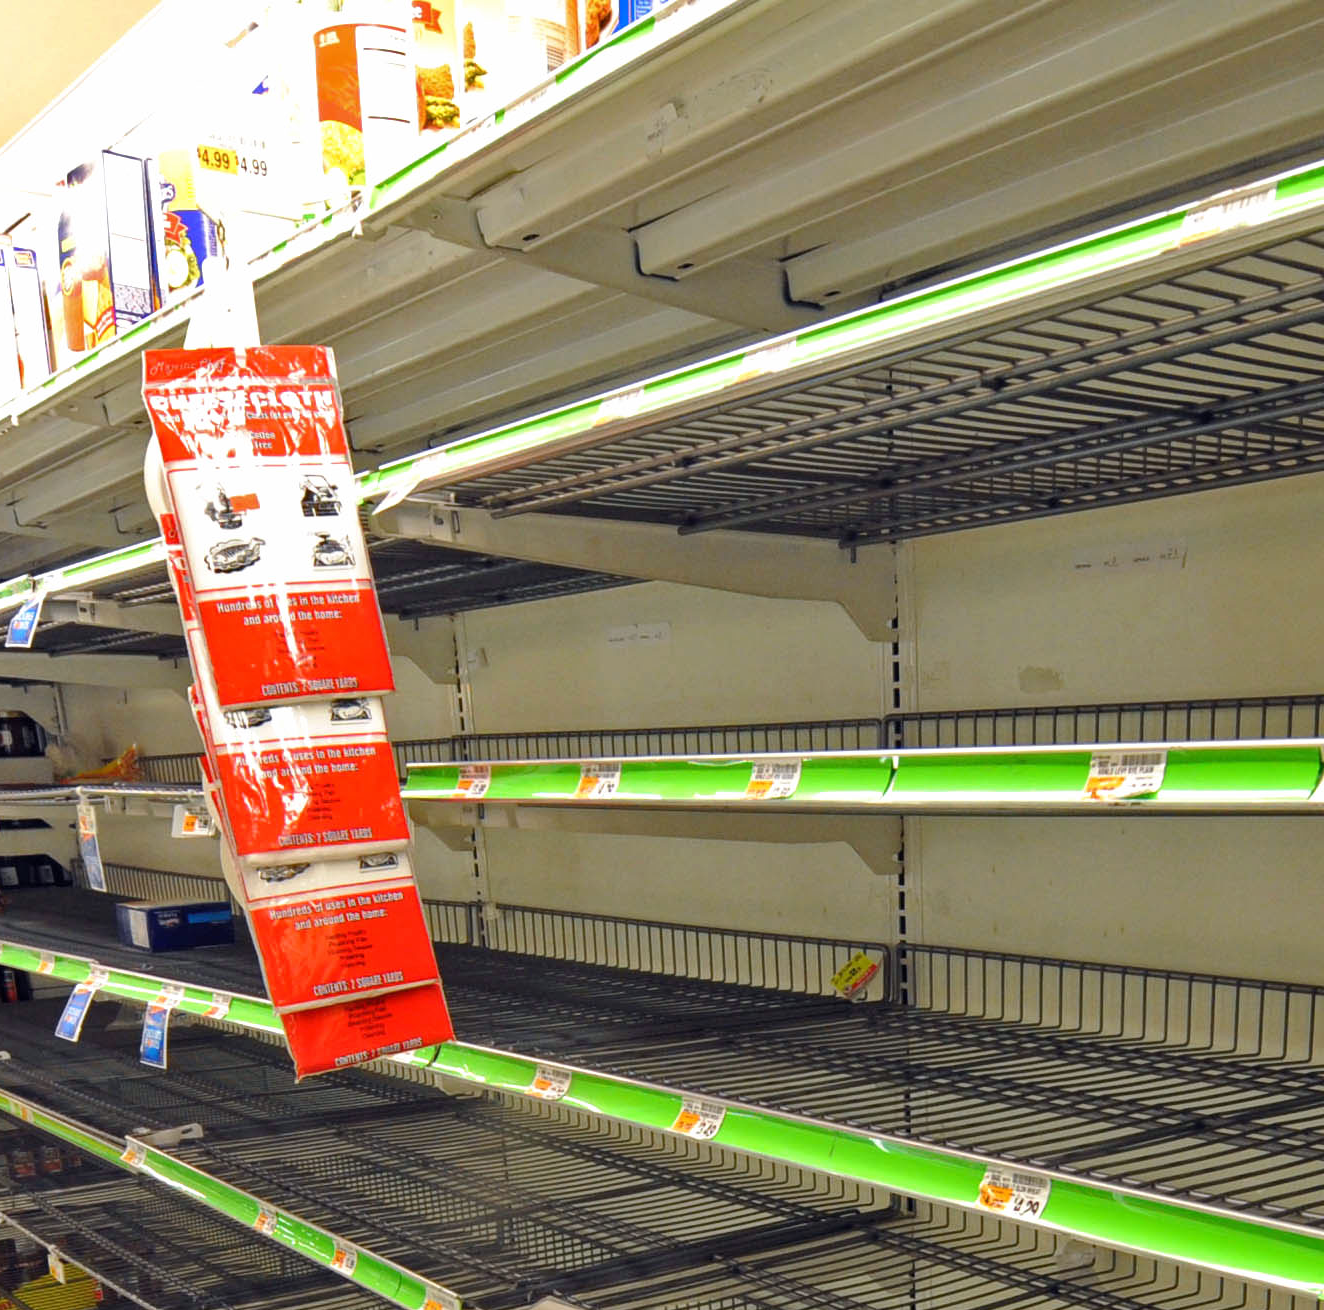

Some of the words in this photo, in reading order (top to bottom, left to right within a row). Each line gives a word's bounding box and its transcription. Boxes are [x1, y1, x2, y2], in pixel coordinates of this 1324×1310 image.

[298, 609, 313, 621] the
[269, 906, 312, 921] Hundreds
[357, 895, 373, 907] the
[372, 891, 404, 904] kitchen
[294, 918, 312, 931] and
[313, 914, 346, 929] around
[346, 911, 361, 923] the
[361, 908, 388, 921] home:
